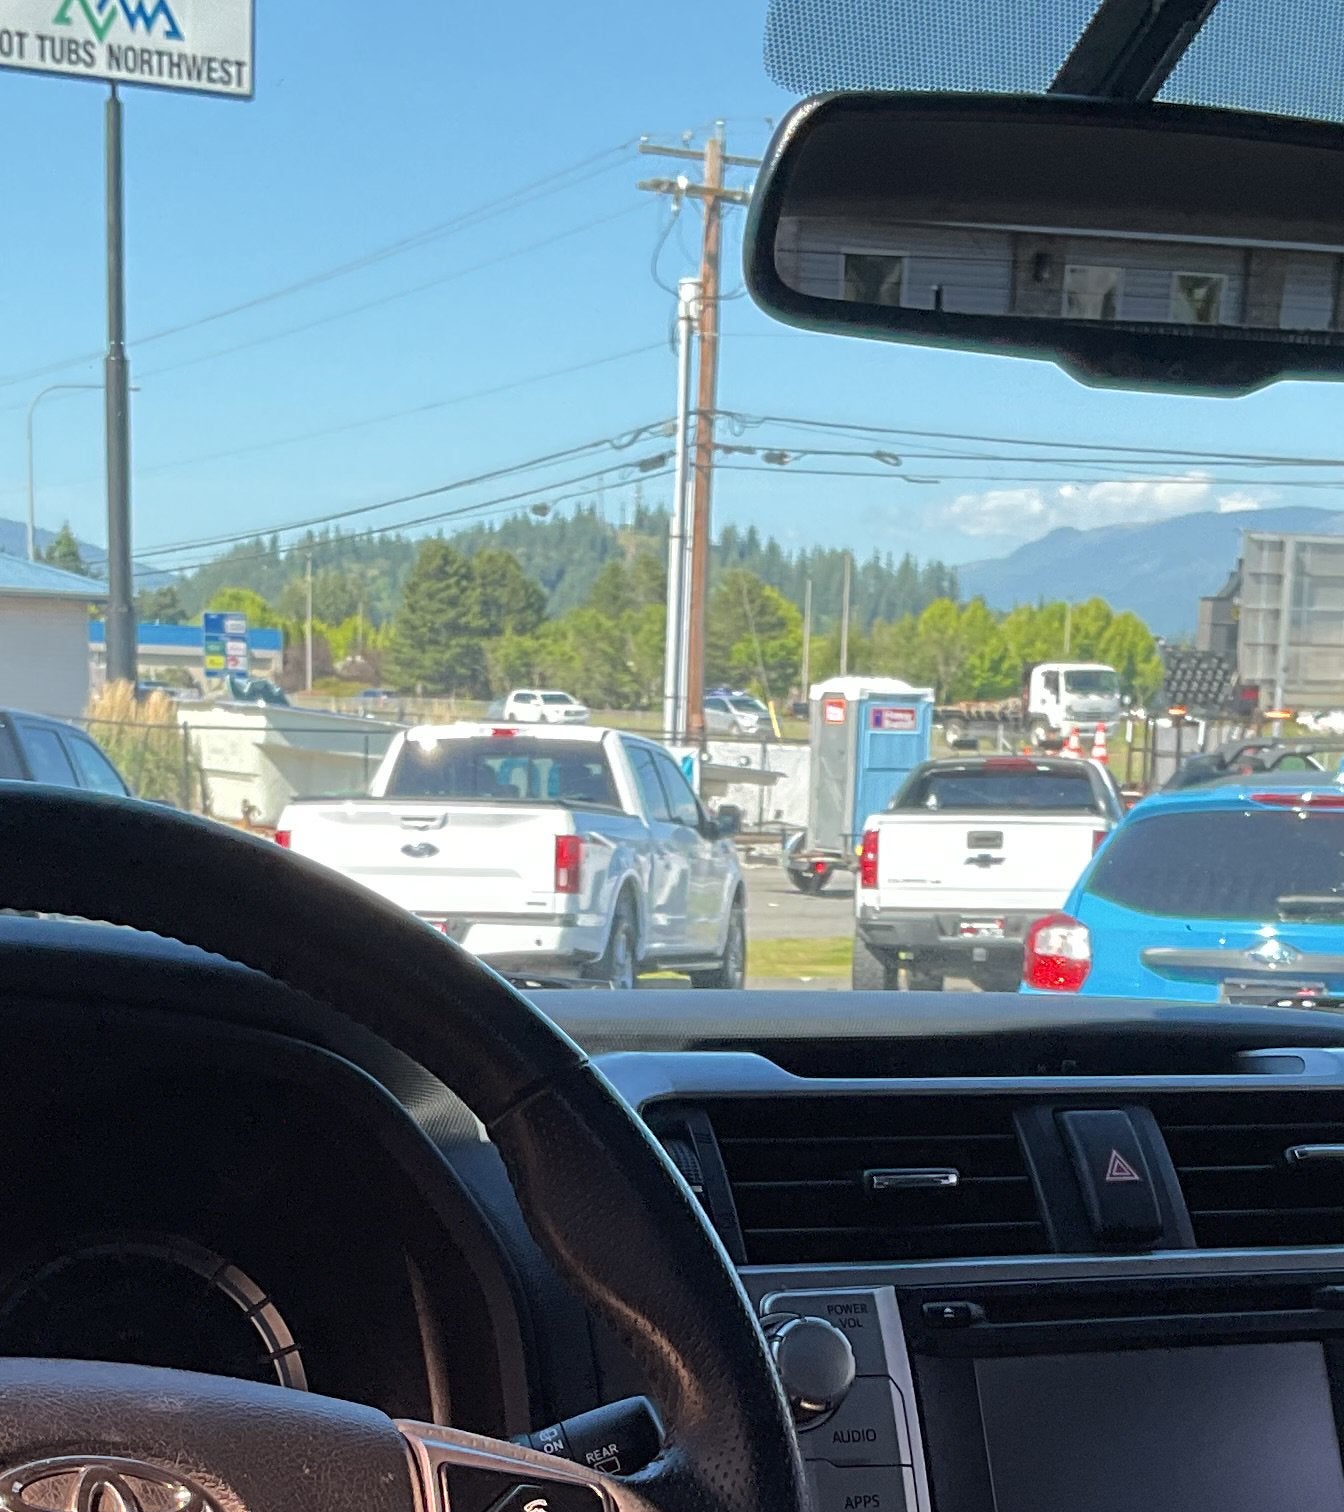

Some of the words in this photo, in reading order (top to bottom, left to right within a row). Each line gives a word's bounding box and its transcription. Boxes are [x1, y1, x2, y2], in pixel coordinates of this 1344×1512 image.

[36, 34, 96, 68] TUBS
[106, 43, 248, 89] NORTHWEST
[826, 1303, 868, 1316] POWER
[839, 1317, 864, 1329] VOL
[832, 1427, 877, 1443] AUDIO
[543, 1438, 565, 1455] ON
[585, 1443, 619, 1464] REAR
[844, 1494, 880, 1510] APPS
